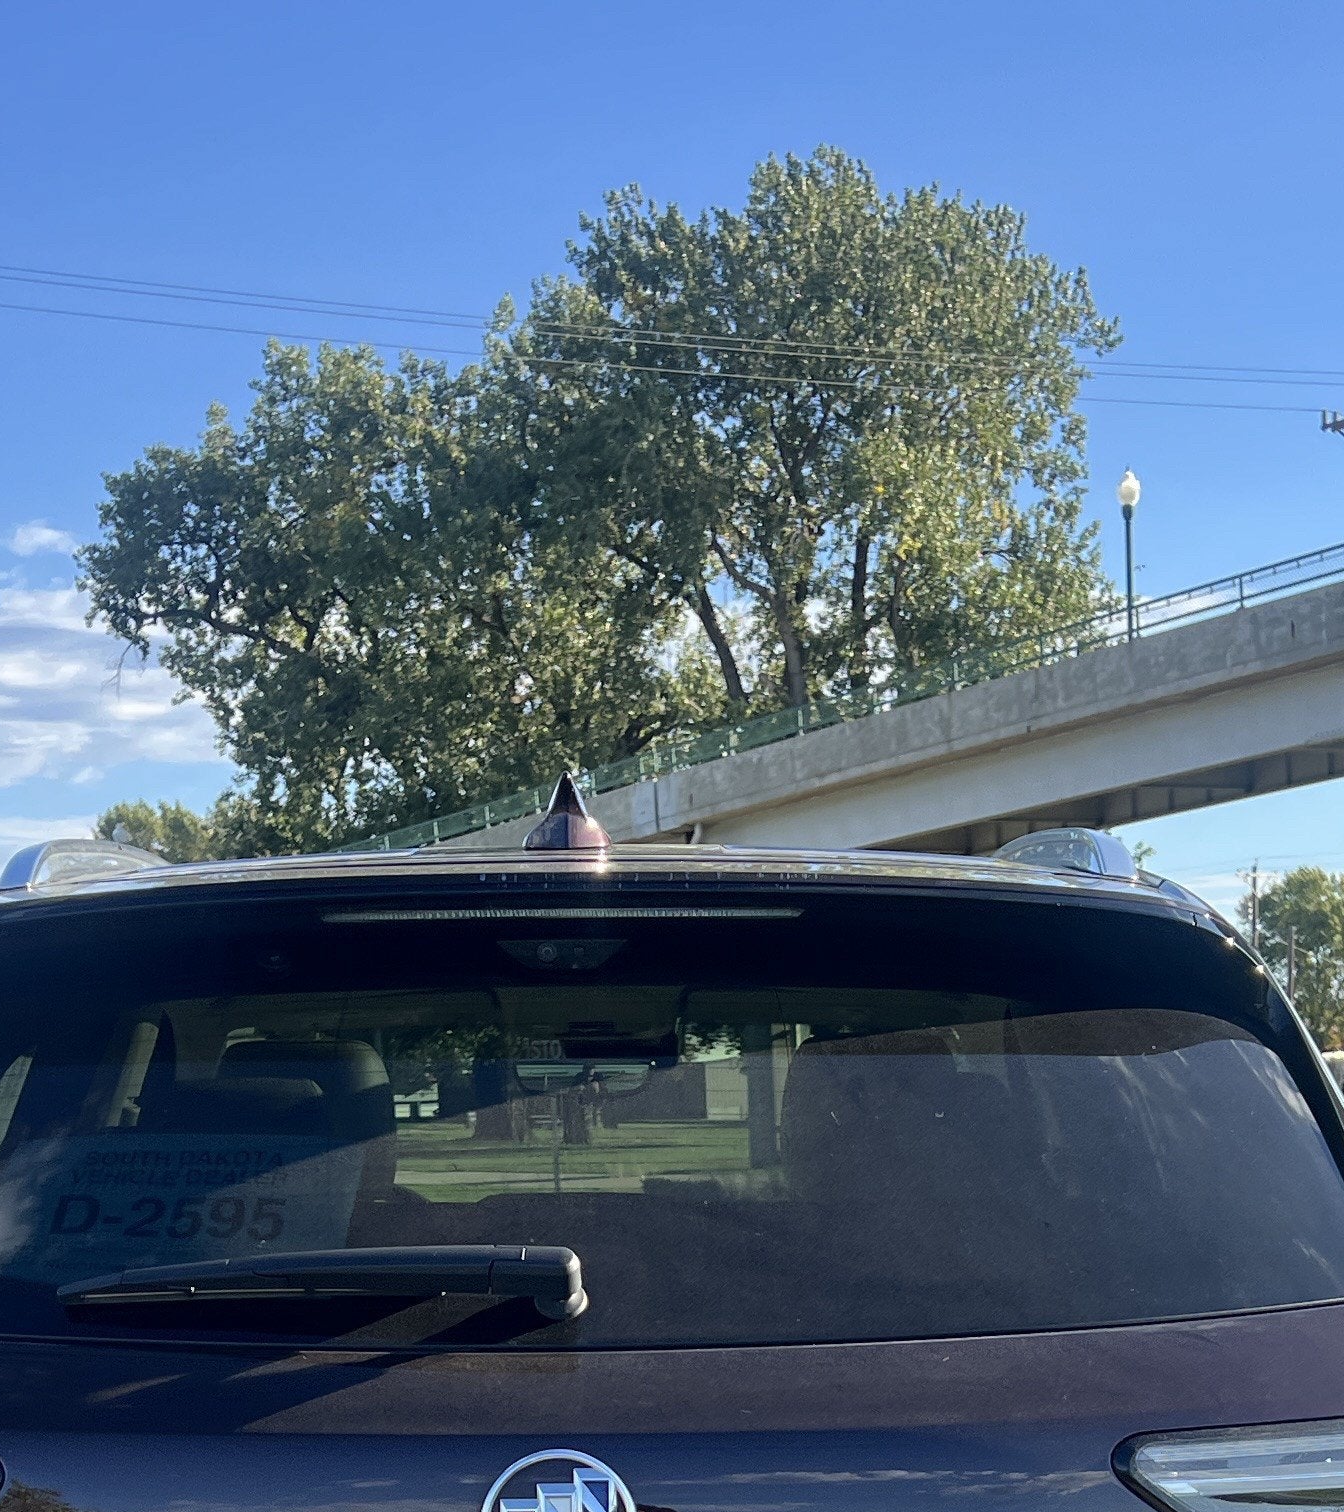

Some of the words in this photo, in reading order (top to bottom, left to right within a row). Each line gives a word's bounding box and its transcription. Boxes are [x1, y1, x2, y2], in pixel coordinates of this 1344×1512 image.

[85, 1150, 171, 1168] SOUTH
[179, 1150, 285, 1168] DAKOTA
[49, 1194, 287, 1242] D-2595
